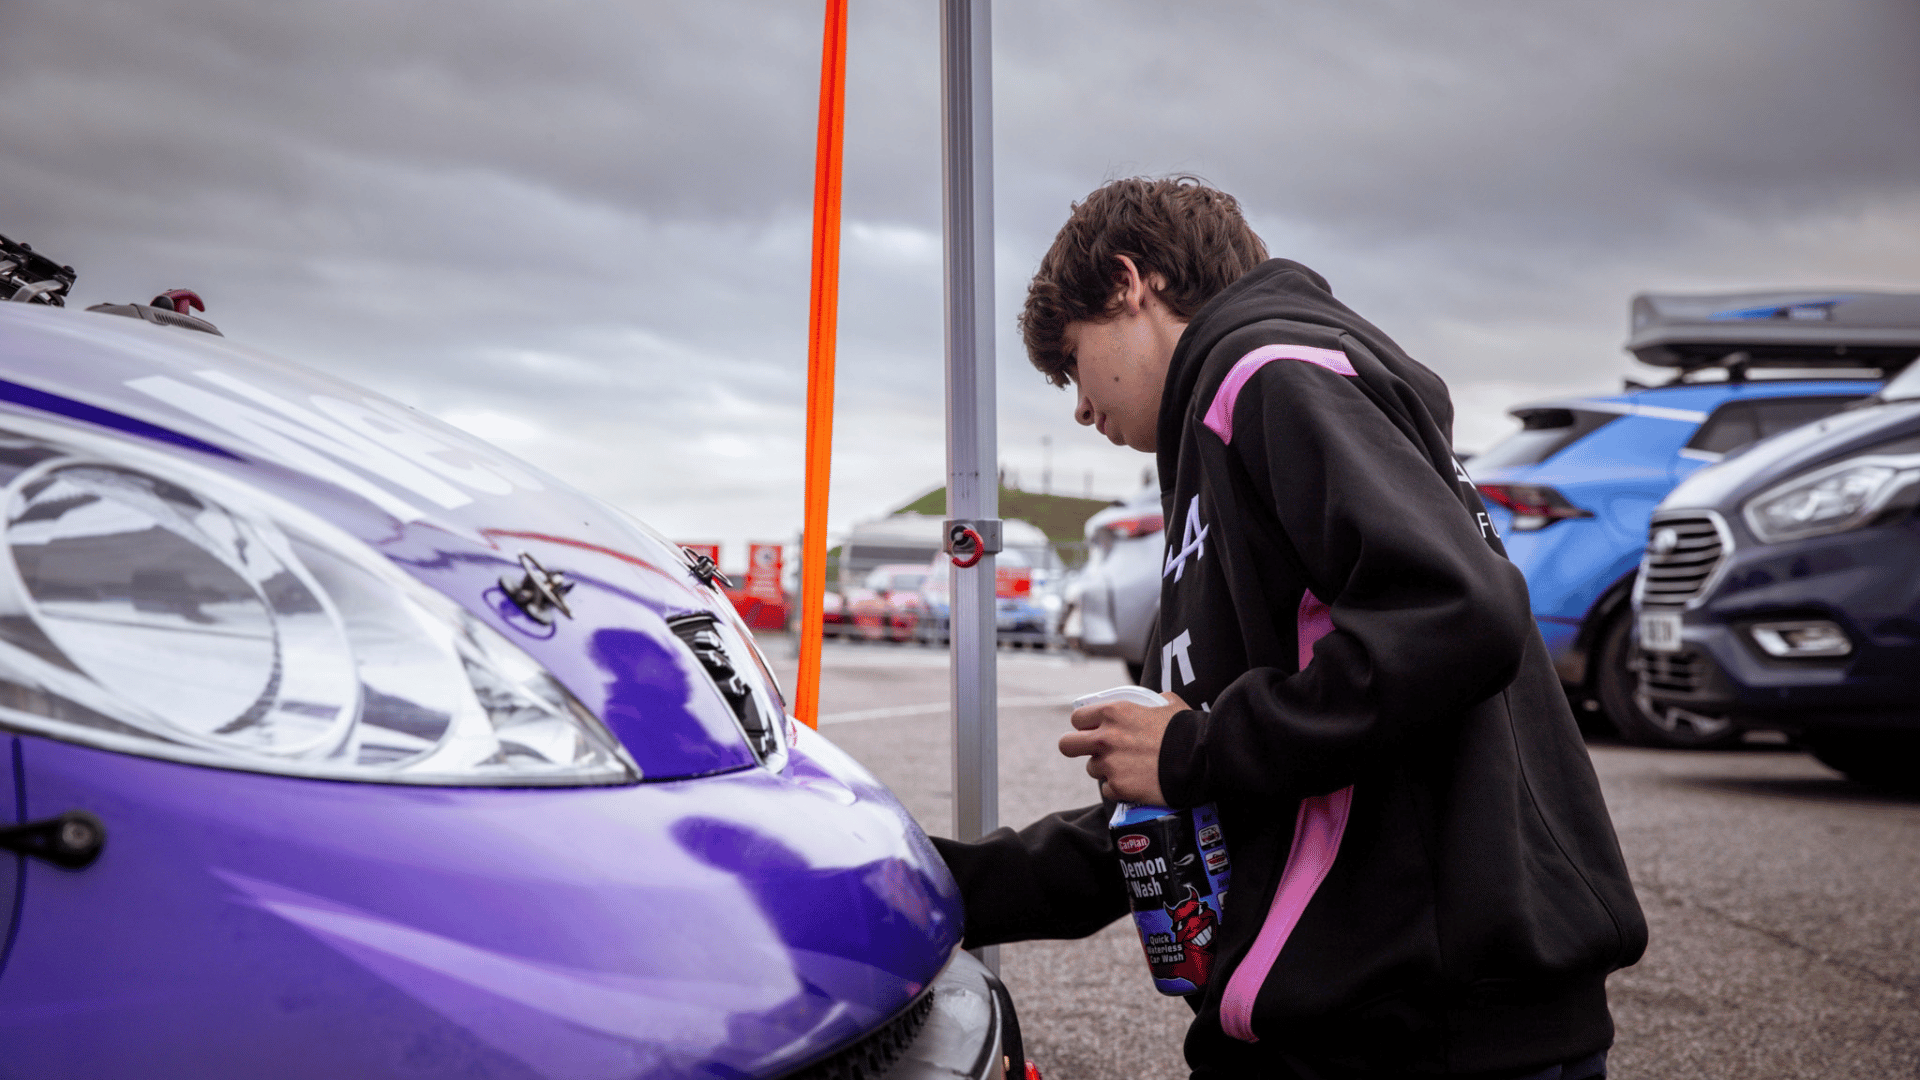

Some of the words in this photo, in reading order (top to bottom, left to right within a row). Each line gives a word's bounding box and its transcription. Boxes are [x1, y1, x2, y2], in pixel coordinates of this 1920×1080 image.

[1119, 838, 1148, 850] CarPlan
[1119, 856, 1167, 879] Demon
[1130, 877, 1163, 898] Wash
[1149, 934, 1170, 946] Quick
[1149, 955, 1160, 964] Car
[1161, 952, 1185, 963] Wash
